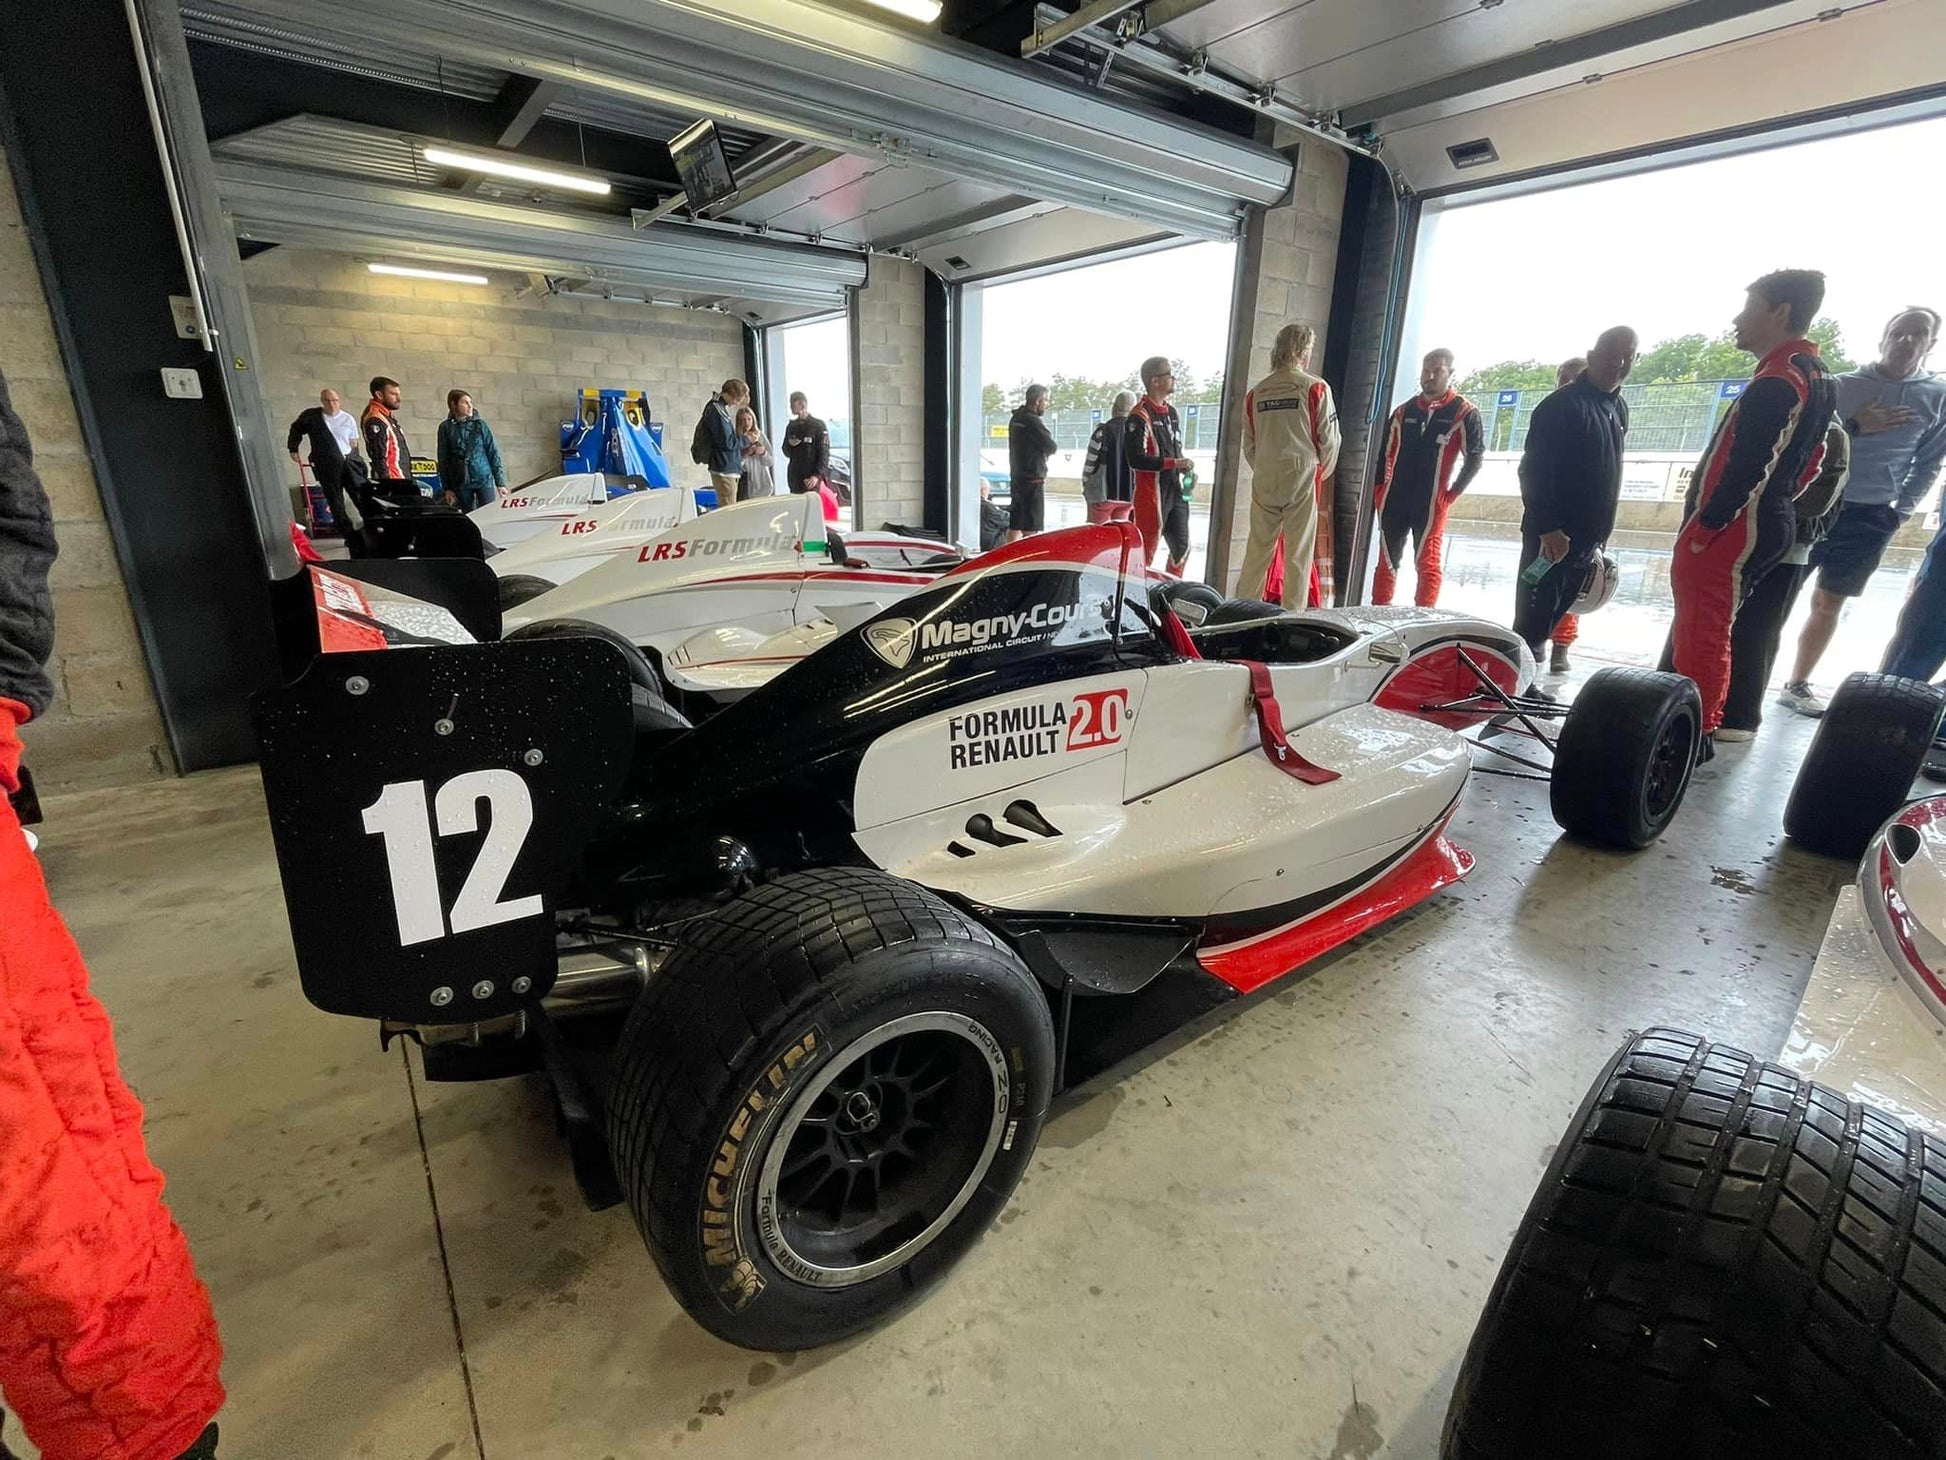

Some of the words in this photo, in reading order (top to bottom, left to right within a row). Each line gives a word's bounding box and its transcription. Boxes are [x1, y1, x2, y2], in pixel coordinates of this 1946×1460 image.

[502, 497, 529, 509] LRS
[561, 520, 598, 536] LRS
[637, 541, 688, 563] LRS
[688, 532, 795, 558] Formula
[923, 641, 1004, 663] INTERNATIONAL
[1006, 633, 1043, 647] CIRCUIT
[950, 701, 1067, 742] FORMULA
[1068, 693, 1126, 748] 2.0
[951, 729, 1060, 770] RENAULT
[361, 768, 544, 947] 12
[967, 1022, 1003, 1065] RACING
[776, 1249, 823, 1281] RENAULT
